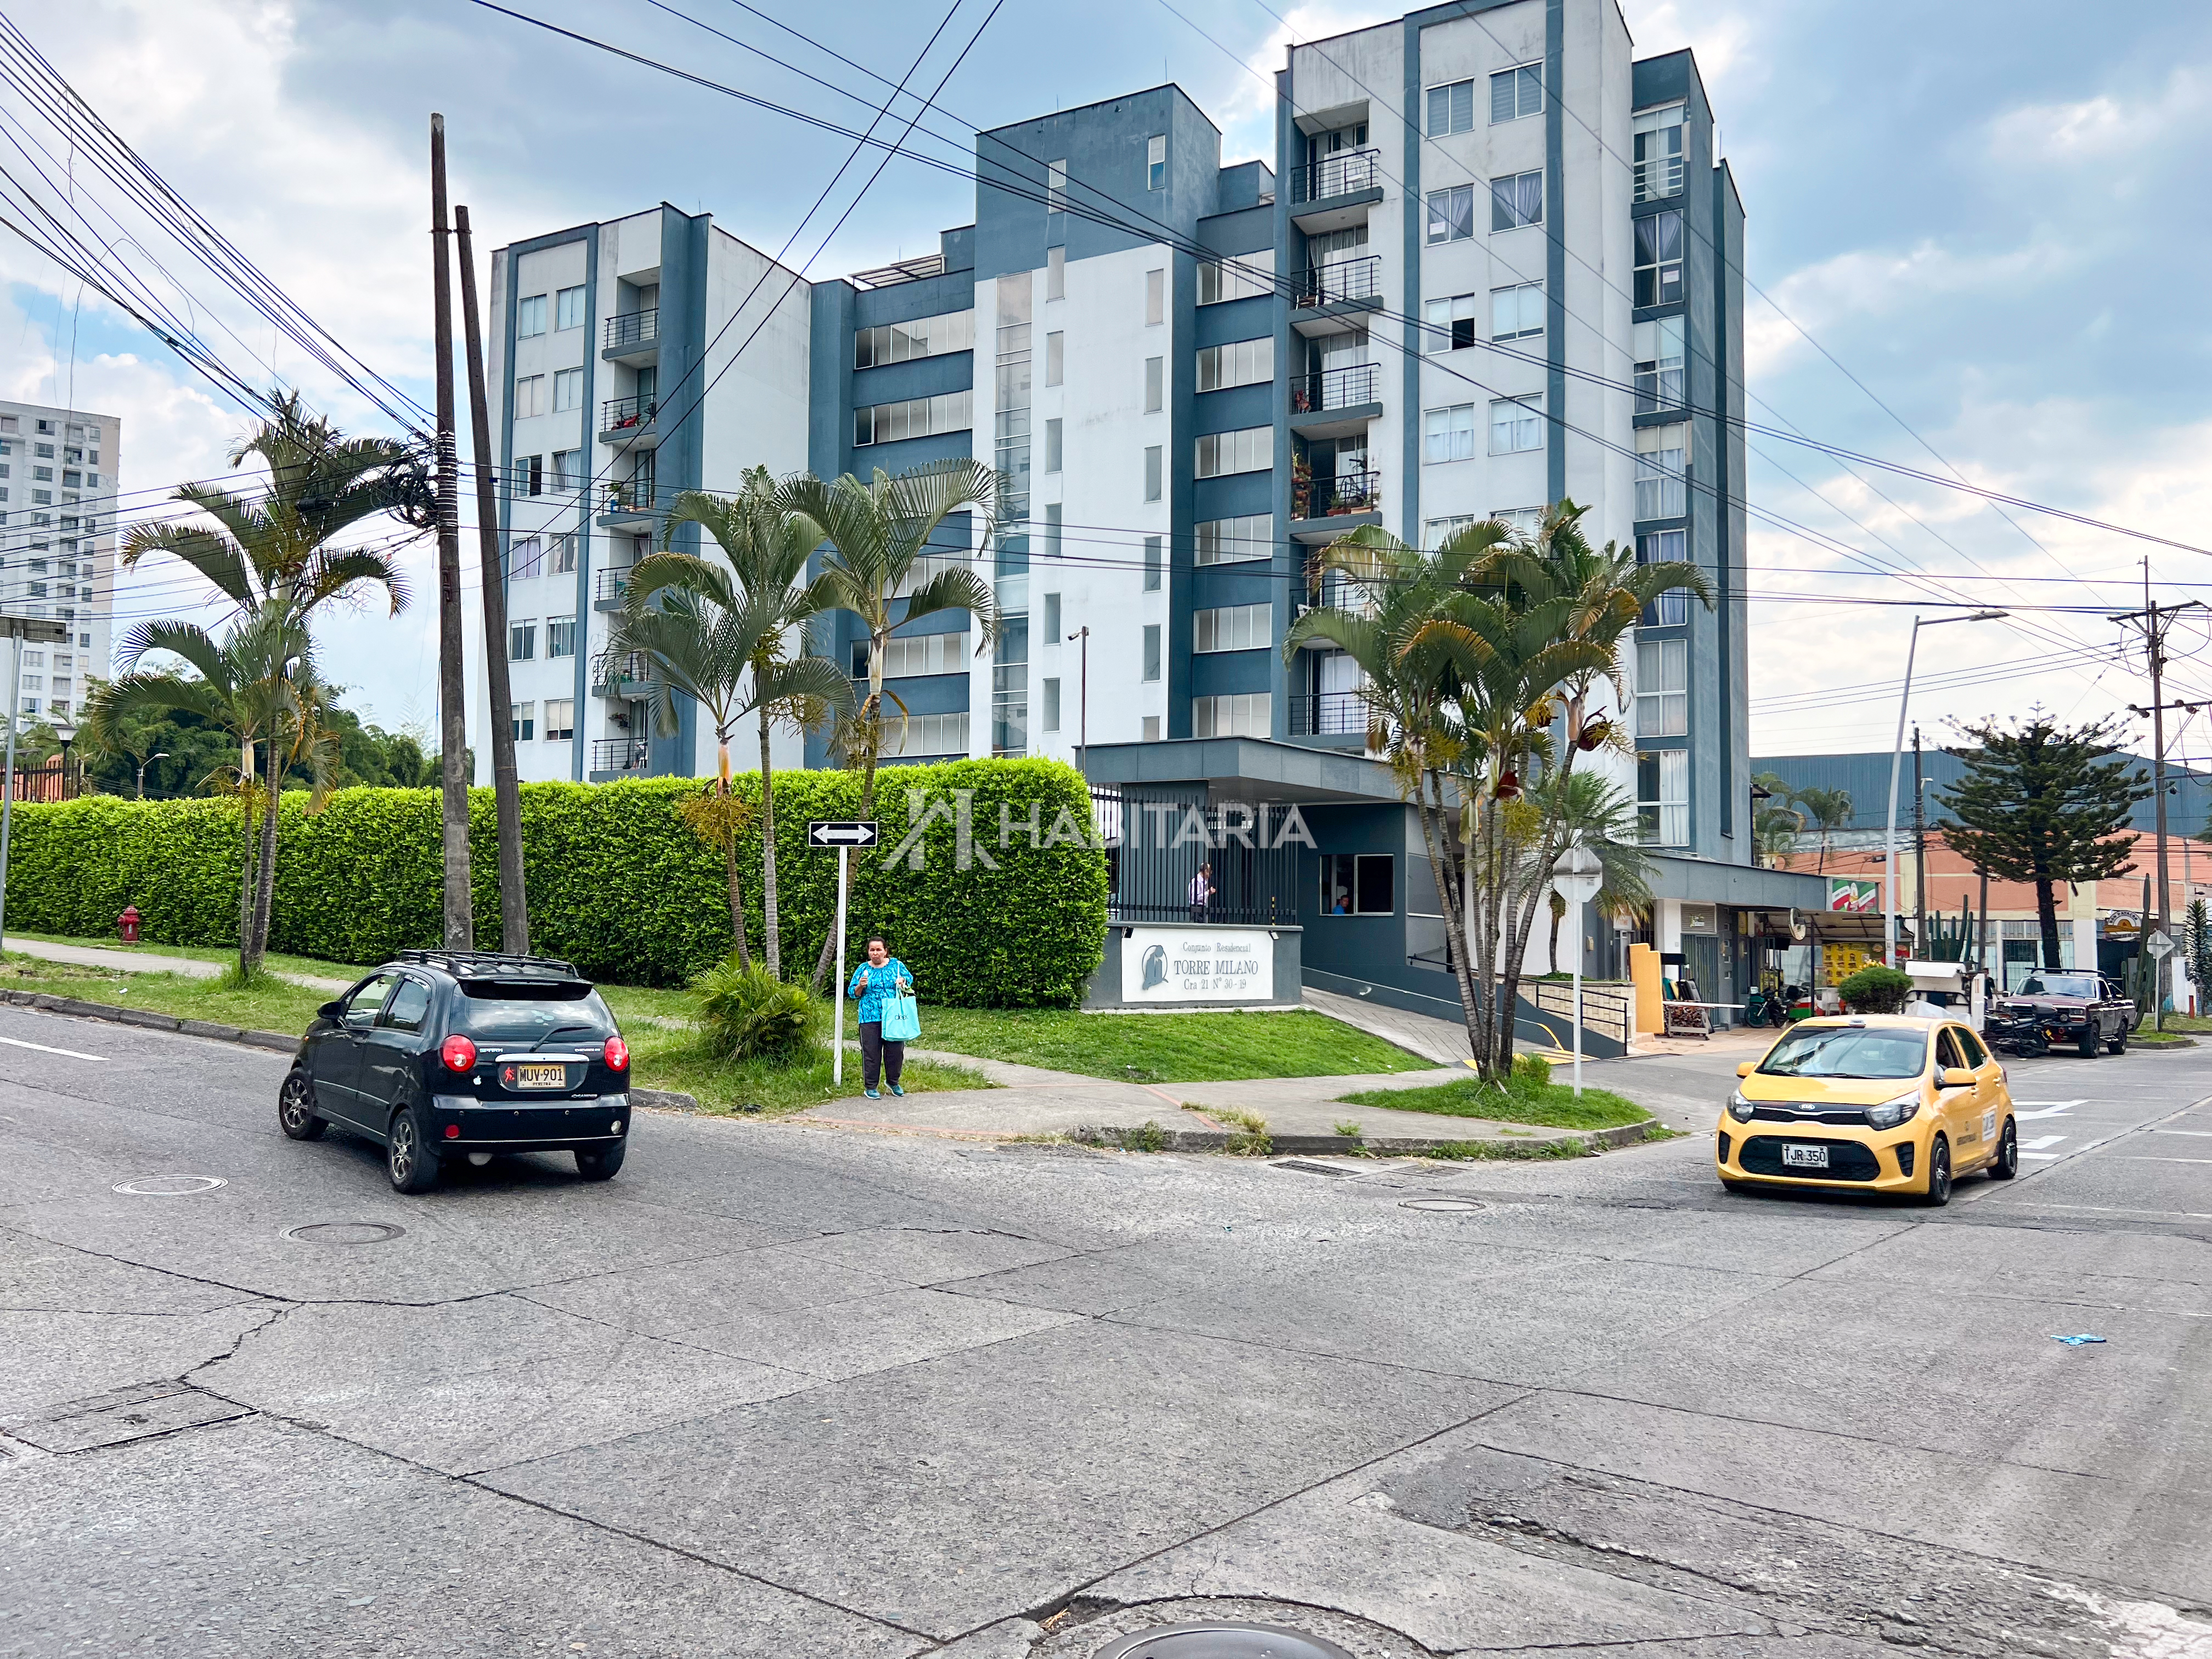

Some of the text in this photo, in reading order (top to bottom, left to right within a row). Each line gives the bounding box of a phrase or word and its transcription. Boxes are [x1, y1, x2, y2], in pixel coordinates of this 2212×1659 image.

[1183, 941, 1251, 953] Conjunto Residencial
[1173, 960, 1259, 975] TORRE MILANO
[1184, 978, 1198, 990] Cra
[1201, 979, 1209, 989] 21
